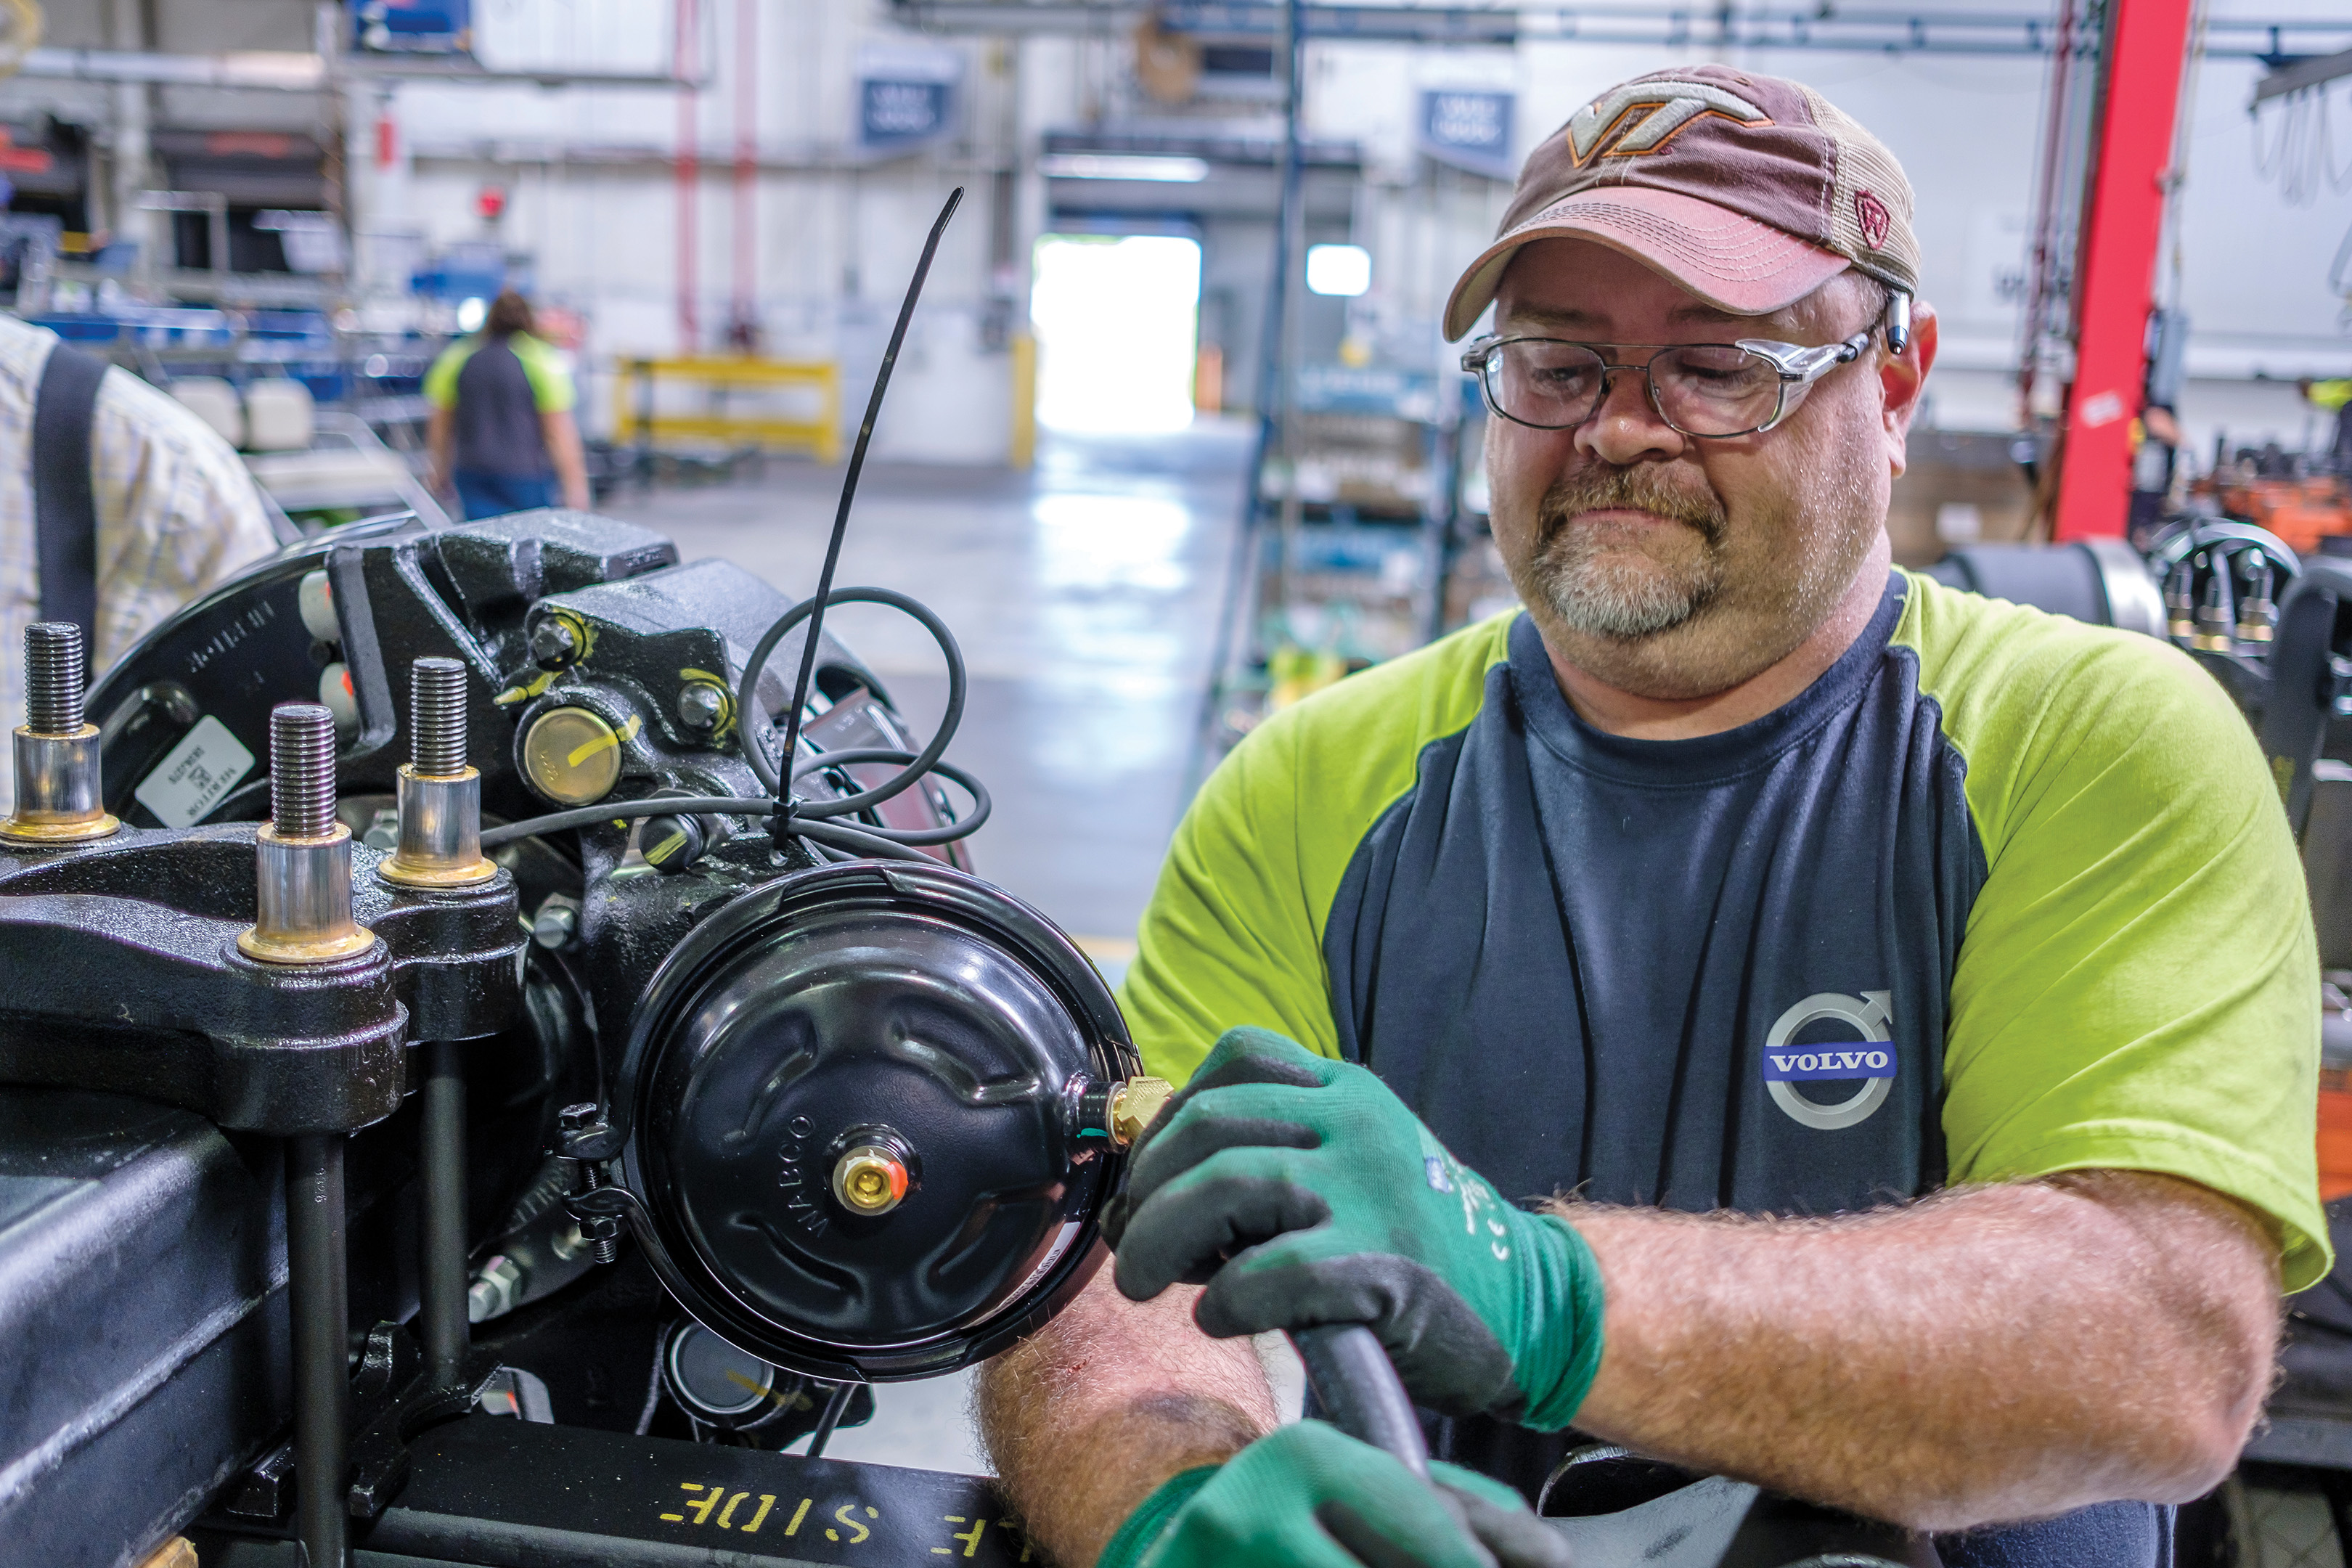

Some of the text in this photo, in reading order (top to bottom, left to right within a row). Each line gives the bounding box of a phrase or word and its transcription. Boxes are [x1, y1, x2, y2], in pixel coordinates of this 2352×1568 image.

[1567, 81, 1775, 168] VT
[1769, 1050, 1888, 1072] VOLVO
[778, 1113, 829, 1238] WABCO
[659, 1482, 879, 1544] SIDE
